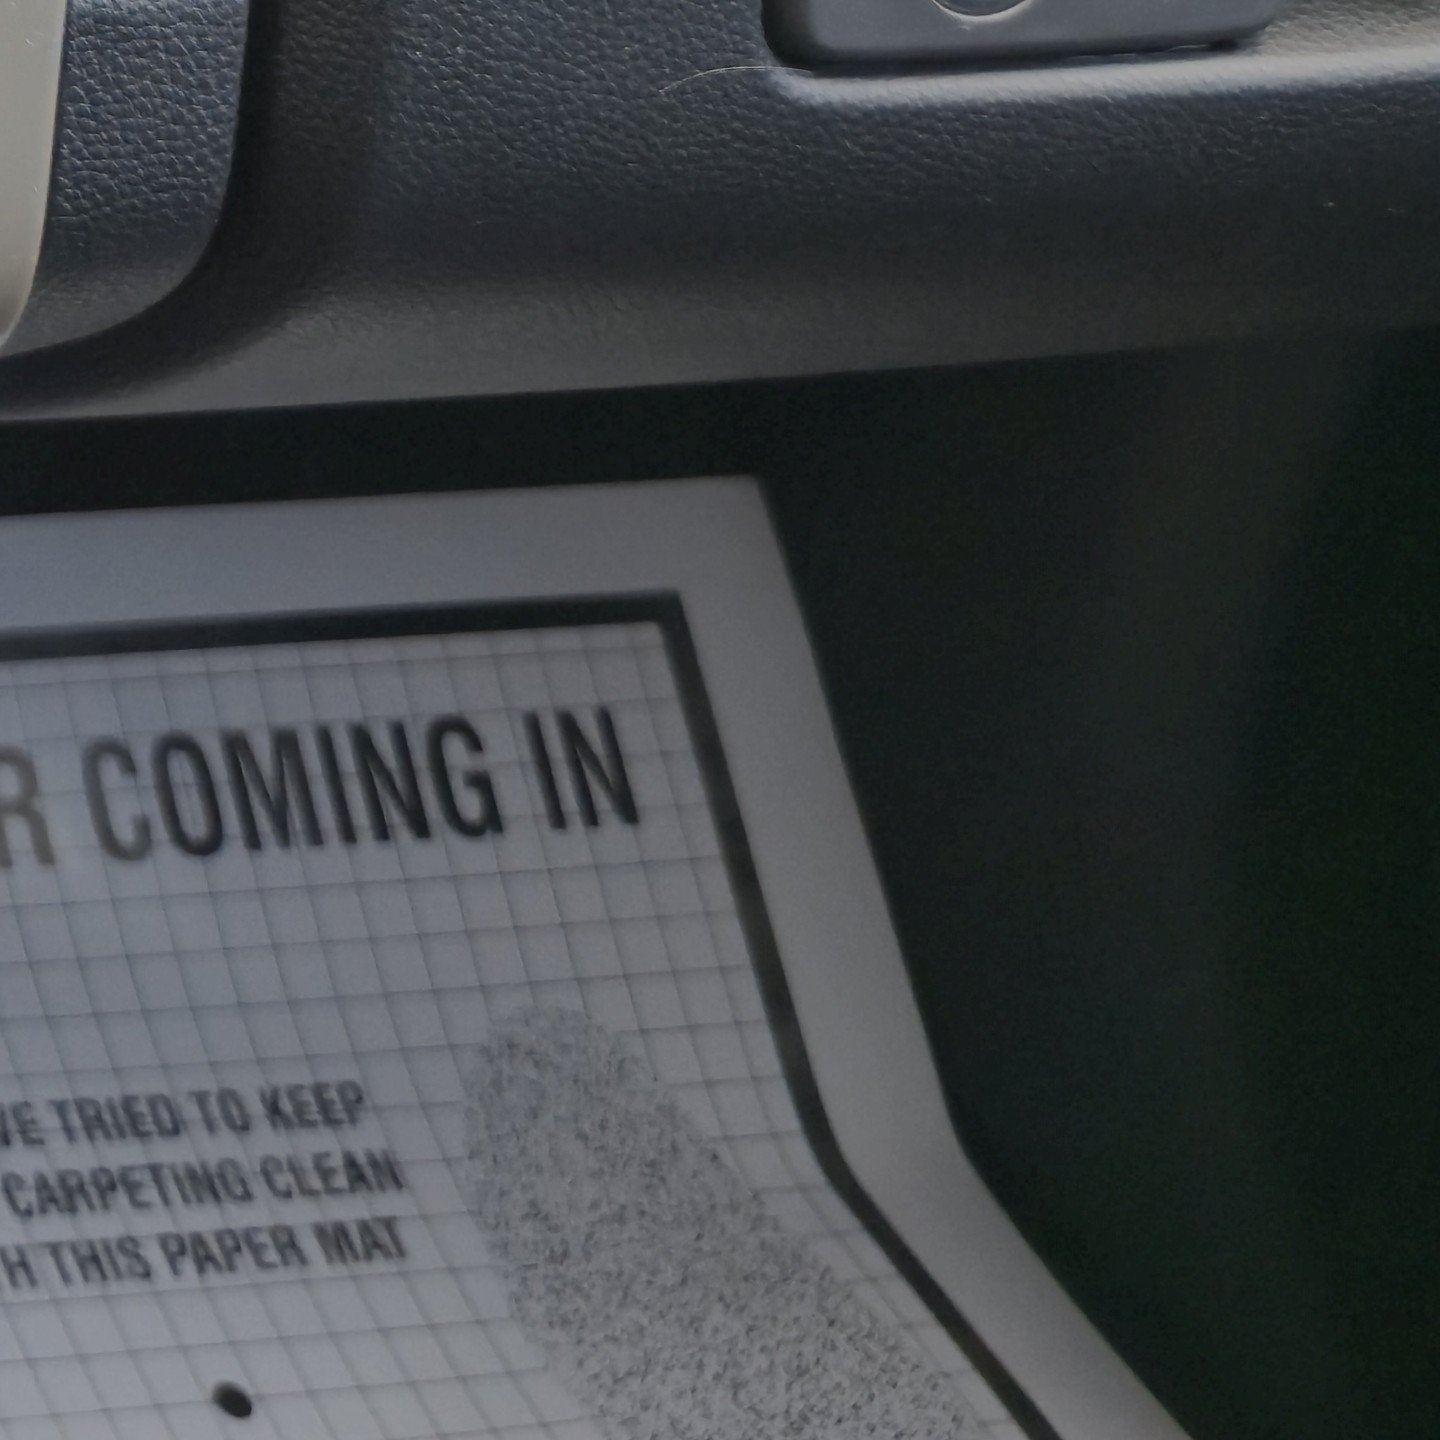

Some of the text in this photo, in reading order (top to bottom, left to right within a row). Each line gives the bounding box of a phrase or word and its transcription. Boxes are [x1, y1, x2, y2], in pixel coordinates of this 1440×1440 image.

[81, 714, 504, 862] COMING
[524, 704, 641, 830] IN
[49, 1092, 182, 1144] TRIED
[187, 1086, 252, 1136] TO
[258, 1079, 365, 1131] KEEP
[0, 1157, 255, 1219] CARPETING
[260, 1148, 405, 1201] CLEAN
[48, 1234, 153, 1287] THIS
[156, 1224, 309, 1277] PAPER
[313, 1215, 409, 1267] MAT
